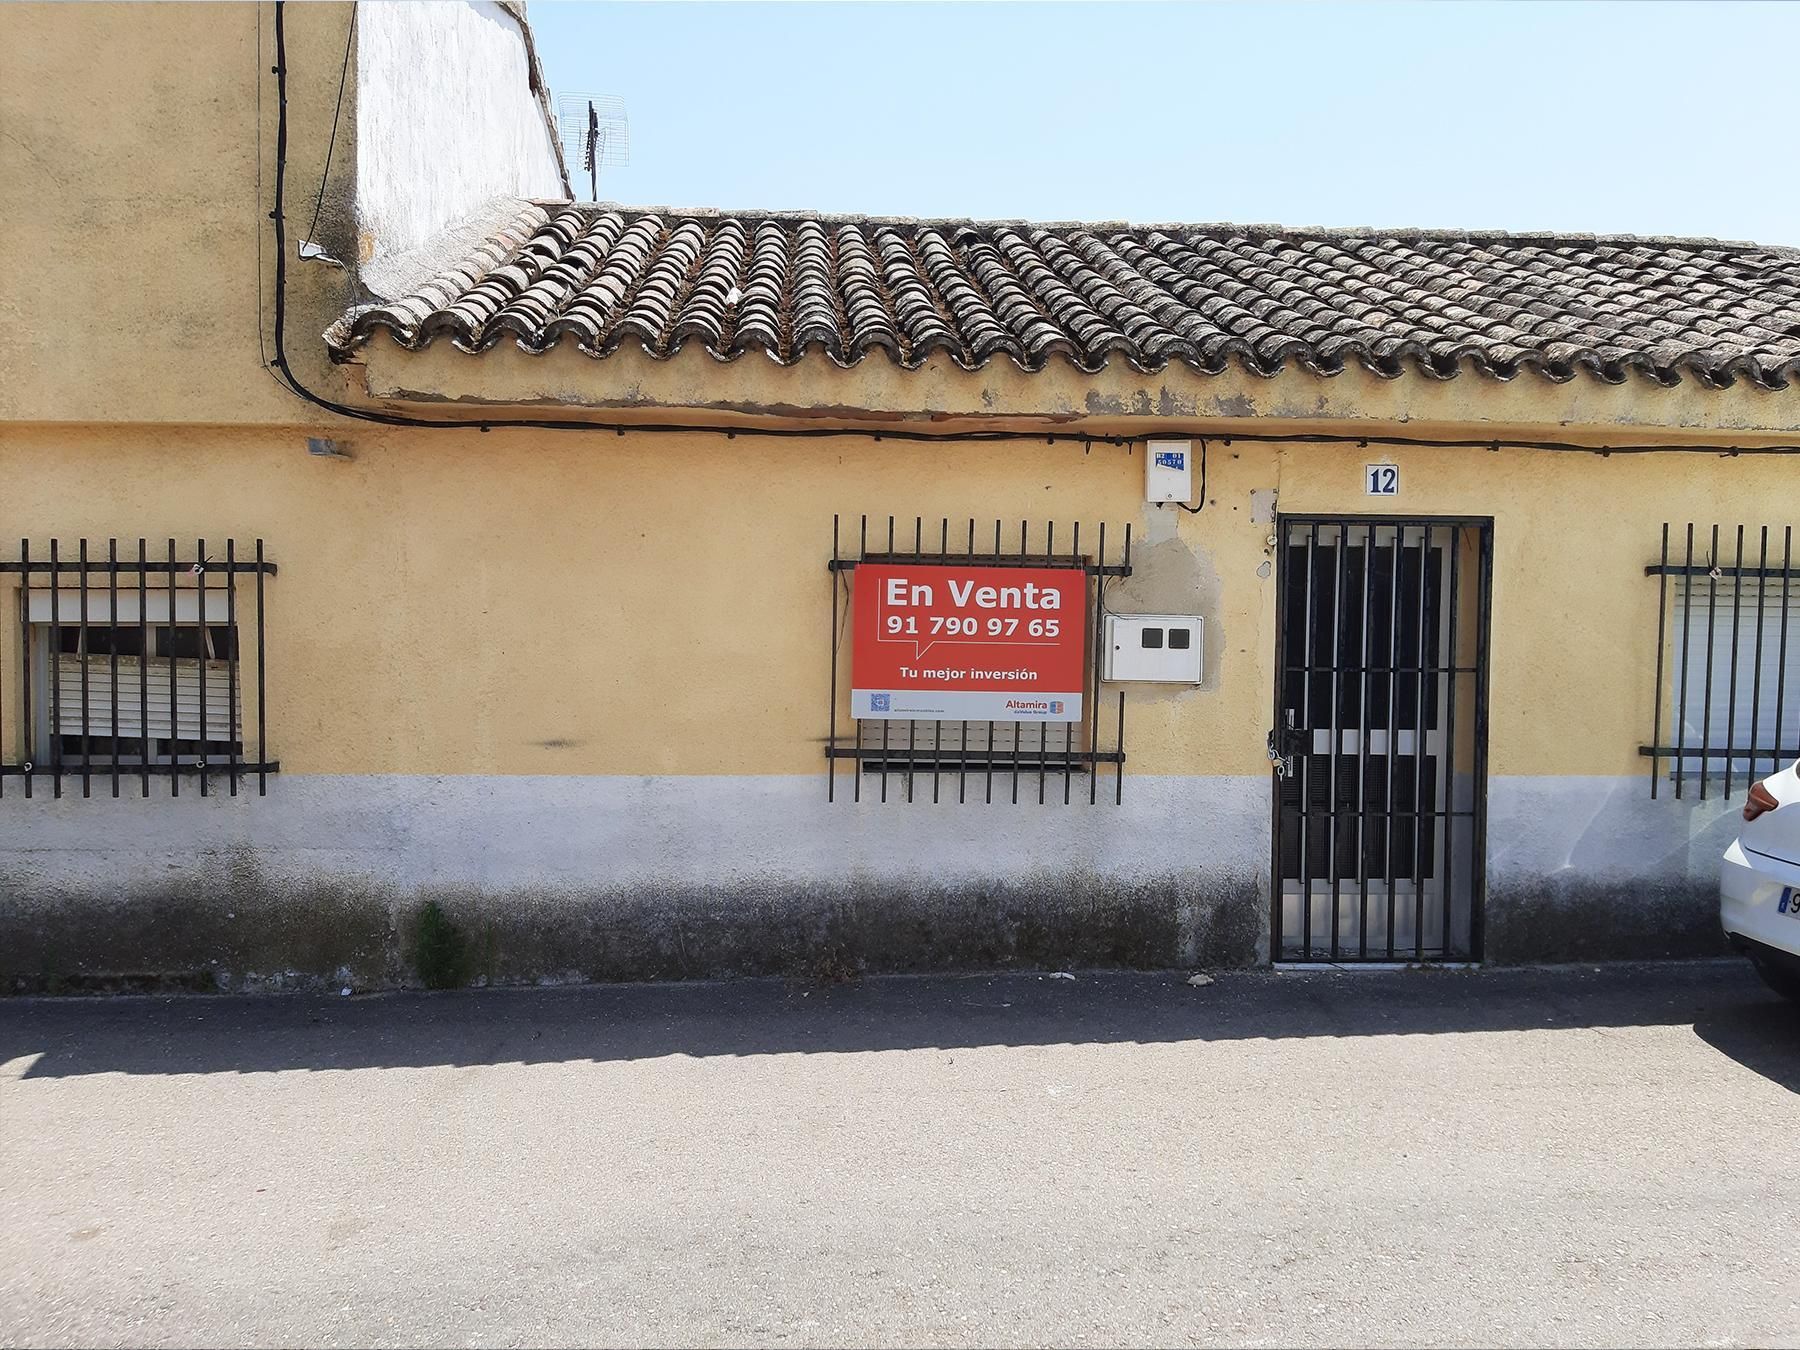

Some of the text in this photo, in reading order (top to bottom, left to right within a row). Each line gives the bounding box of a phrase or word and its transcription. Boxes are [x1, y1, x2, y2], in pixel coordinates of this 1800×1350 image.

[1370, 468, 1396, 493] 12
[887, 578, 1061, 610] En Venta
[887, 616, 1060, 637] 91 790 97 65
[900, 667, 1038, 681] Tu mejor inversión
[1005, 700, 1048, 709] Altamira
